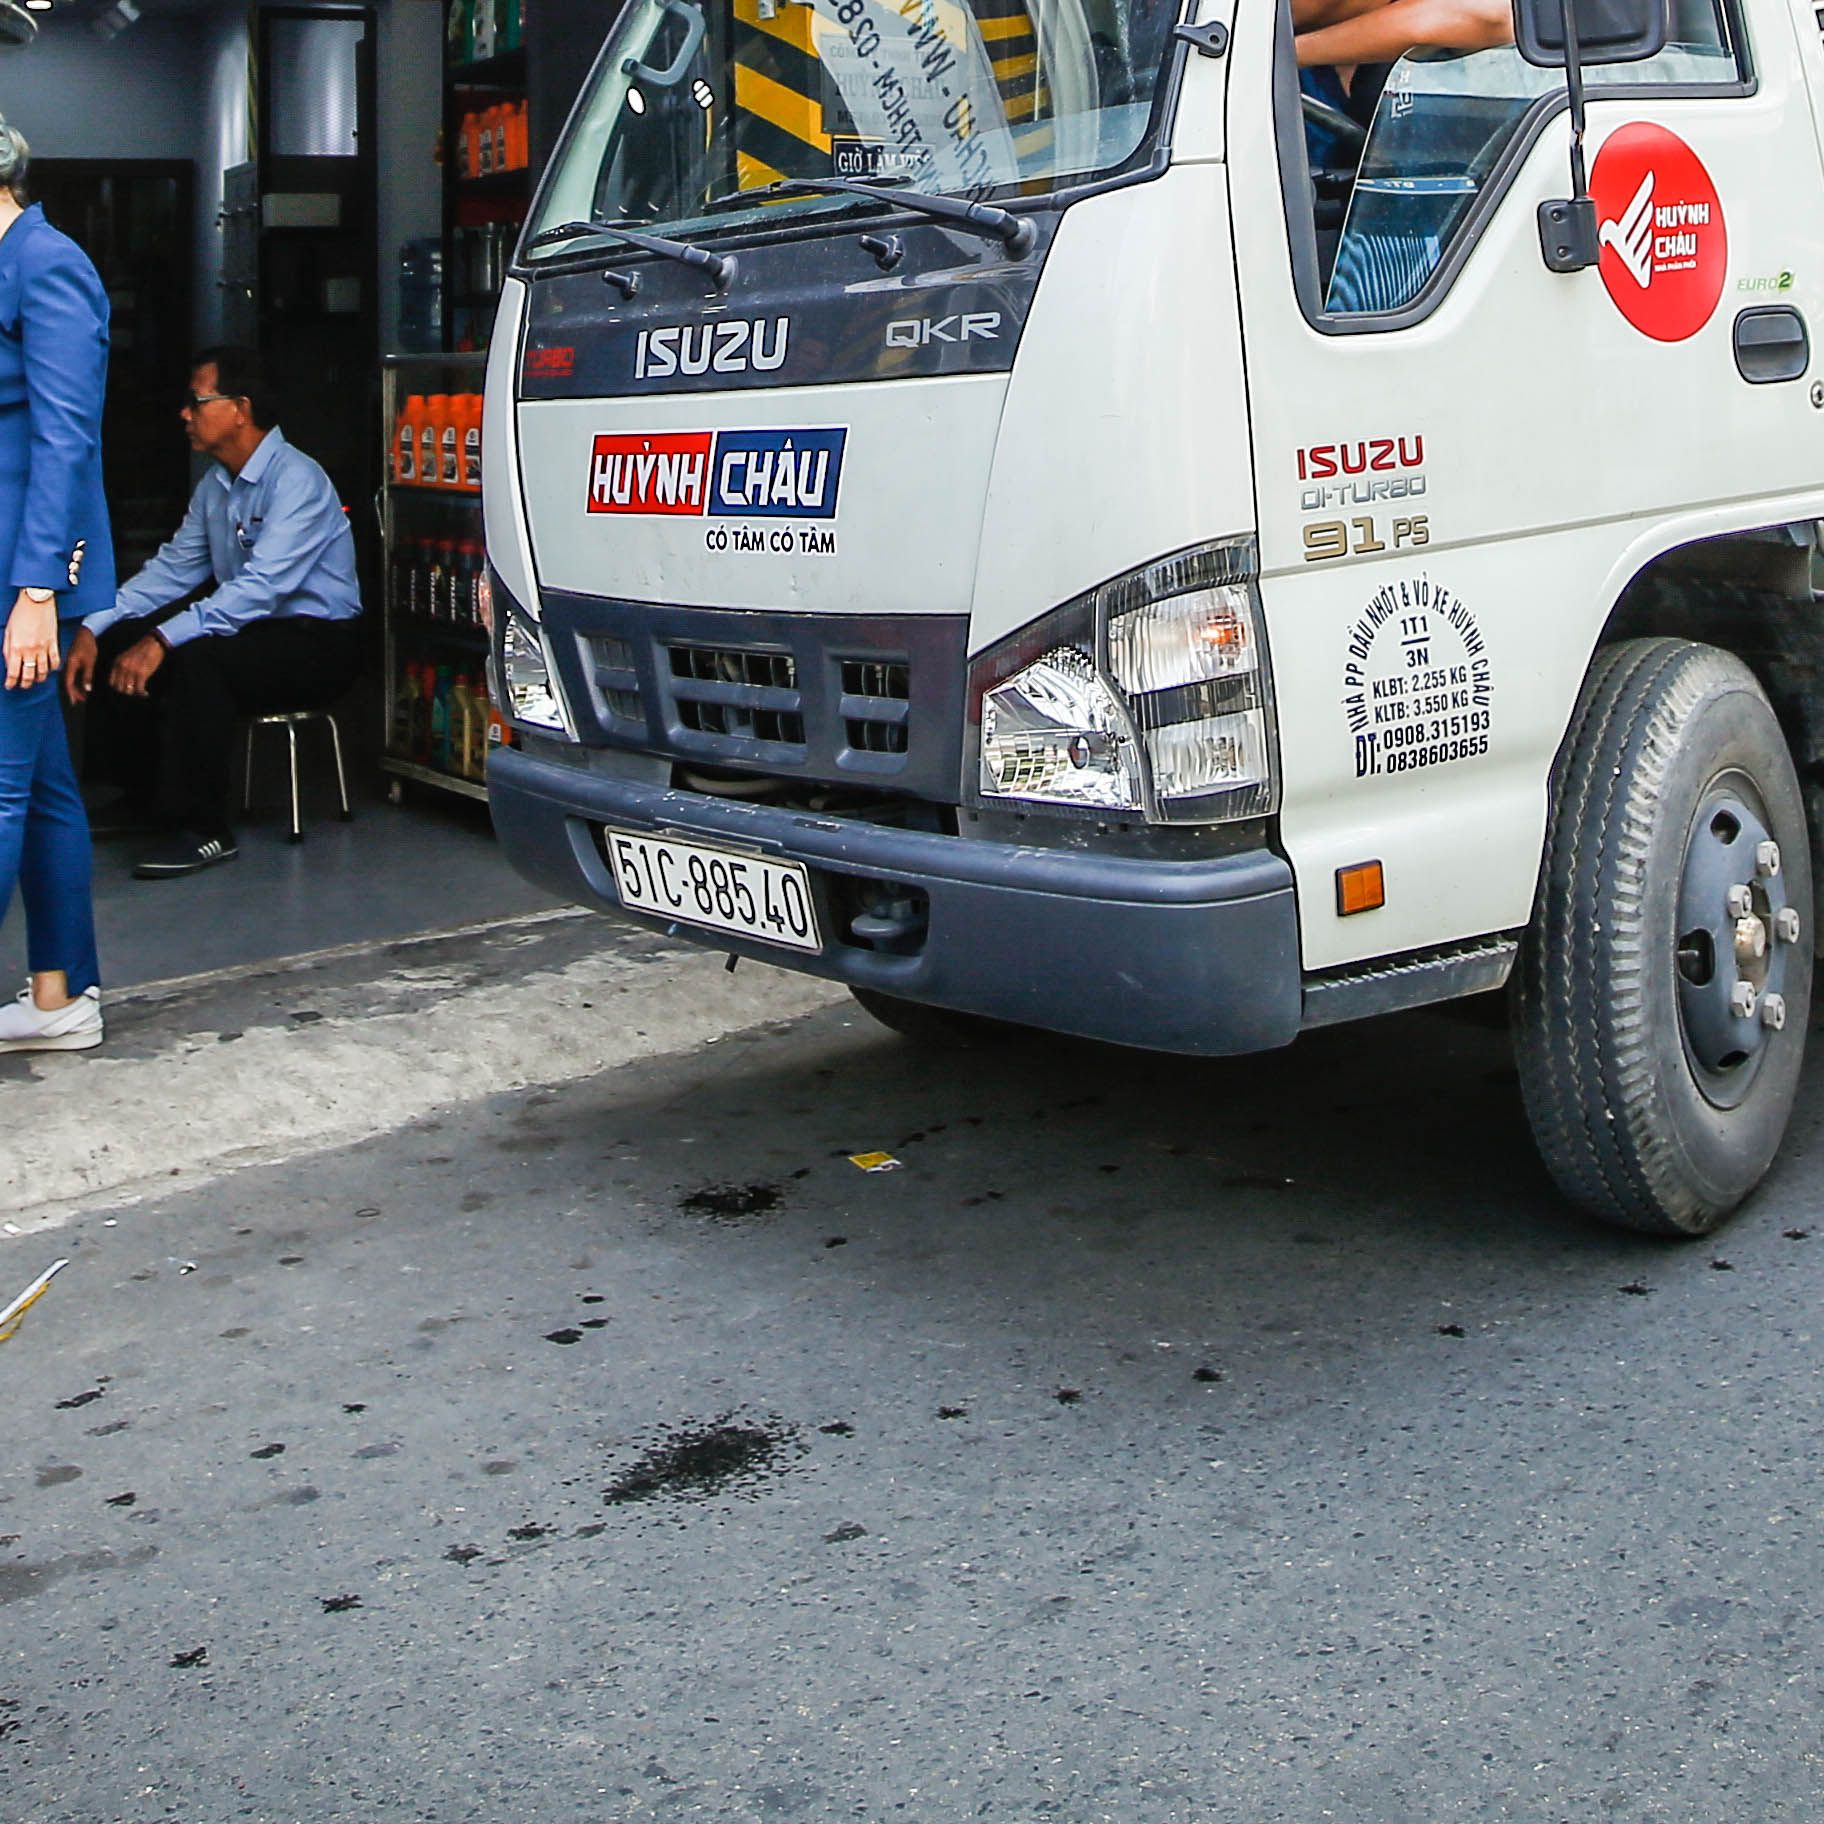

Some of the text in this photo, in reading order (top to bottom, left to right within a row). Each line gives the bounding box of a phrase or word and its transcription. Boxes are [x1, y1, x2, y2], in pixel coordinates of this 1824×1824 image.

[838, 150, 865, 173] GIỜ
[1655, 200, 1710, 228] HUỲNH
[1654, 231, 1697, 259] CHÂU
[635, 316, 789, 379] ISUZU
[886, 311, 1001, 349] QKR
[592, 437, 830, 508] HUỲNH CHÂU
[1296, 434, 1424, 481] ISUZU
[706, 524, 727, 552] CÓ
[733, 525, 765, 553] TÂM
[770, 524, 794, 553] CÓ
[1302, 515, 1430, 563] 91 PS
[1400, 615, 1428, 636] 1T1
[1342, 571, 1495, 734] NHÀ PP DẦU NHỚT & VỎ XE HUỲNH CHÂU
[1406, 647, 1430, 668] 3N
[1373, 665, 1468, 699] KLBT: 2.255 KG
[1374, 689, 1469, 725] KLTB: 3.550 KG
[1384, 710, 1490, 750] 0908.315193
[1386, 735, 1489, 775] 0838603655
[617, 847, 808, 942] 51C-885.40
